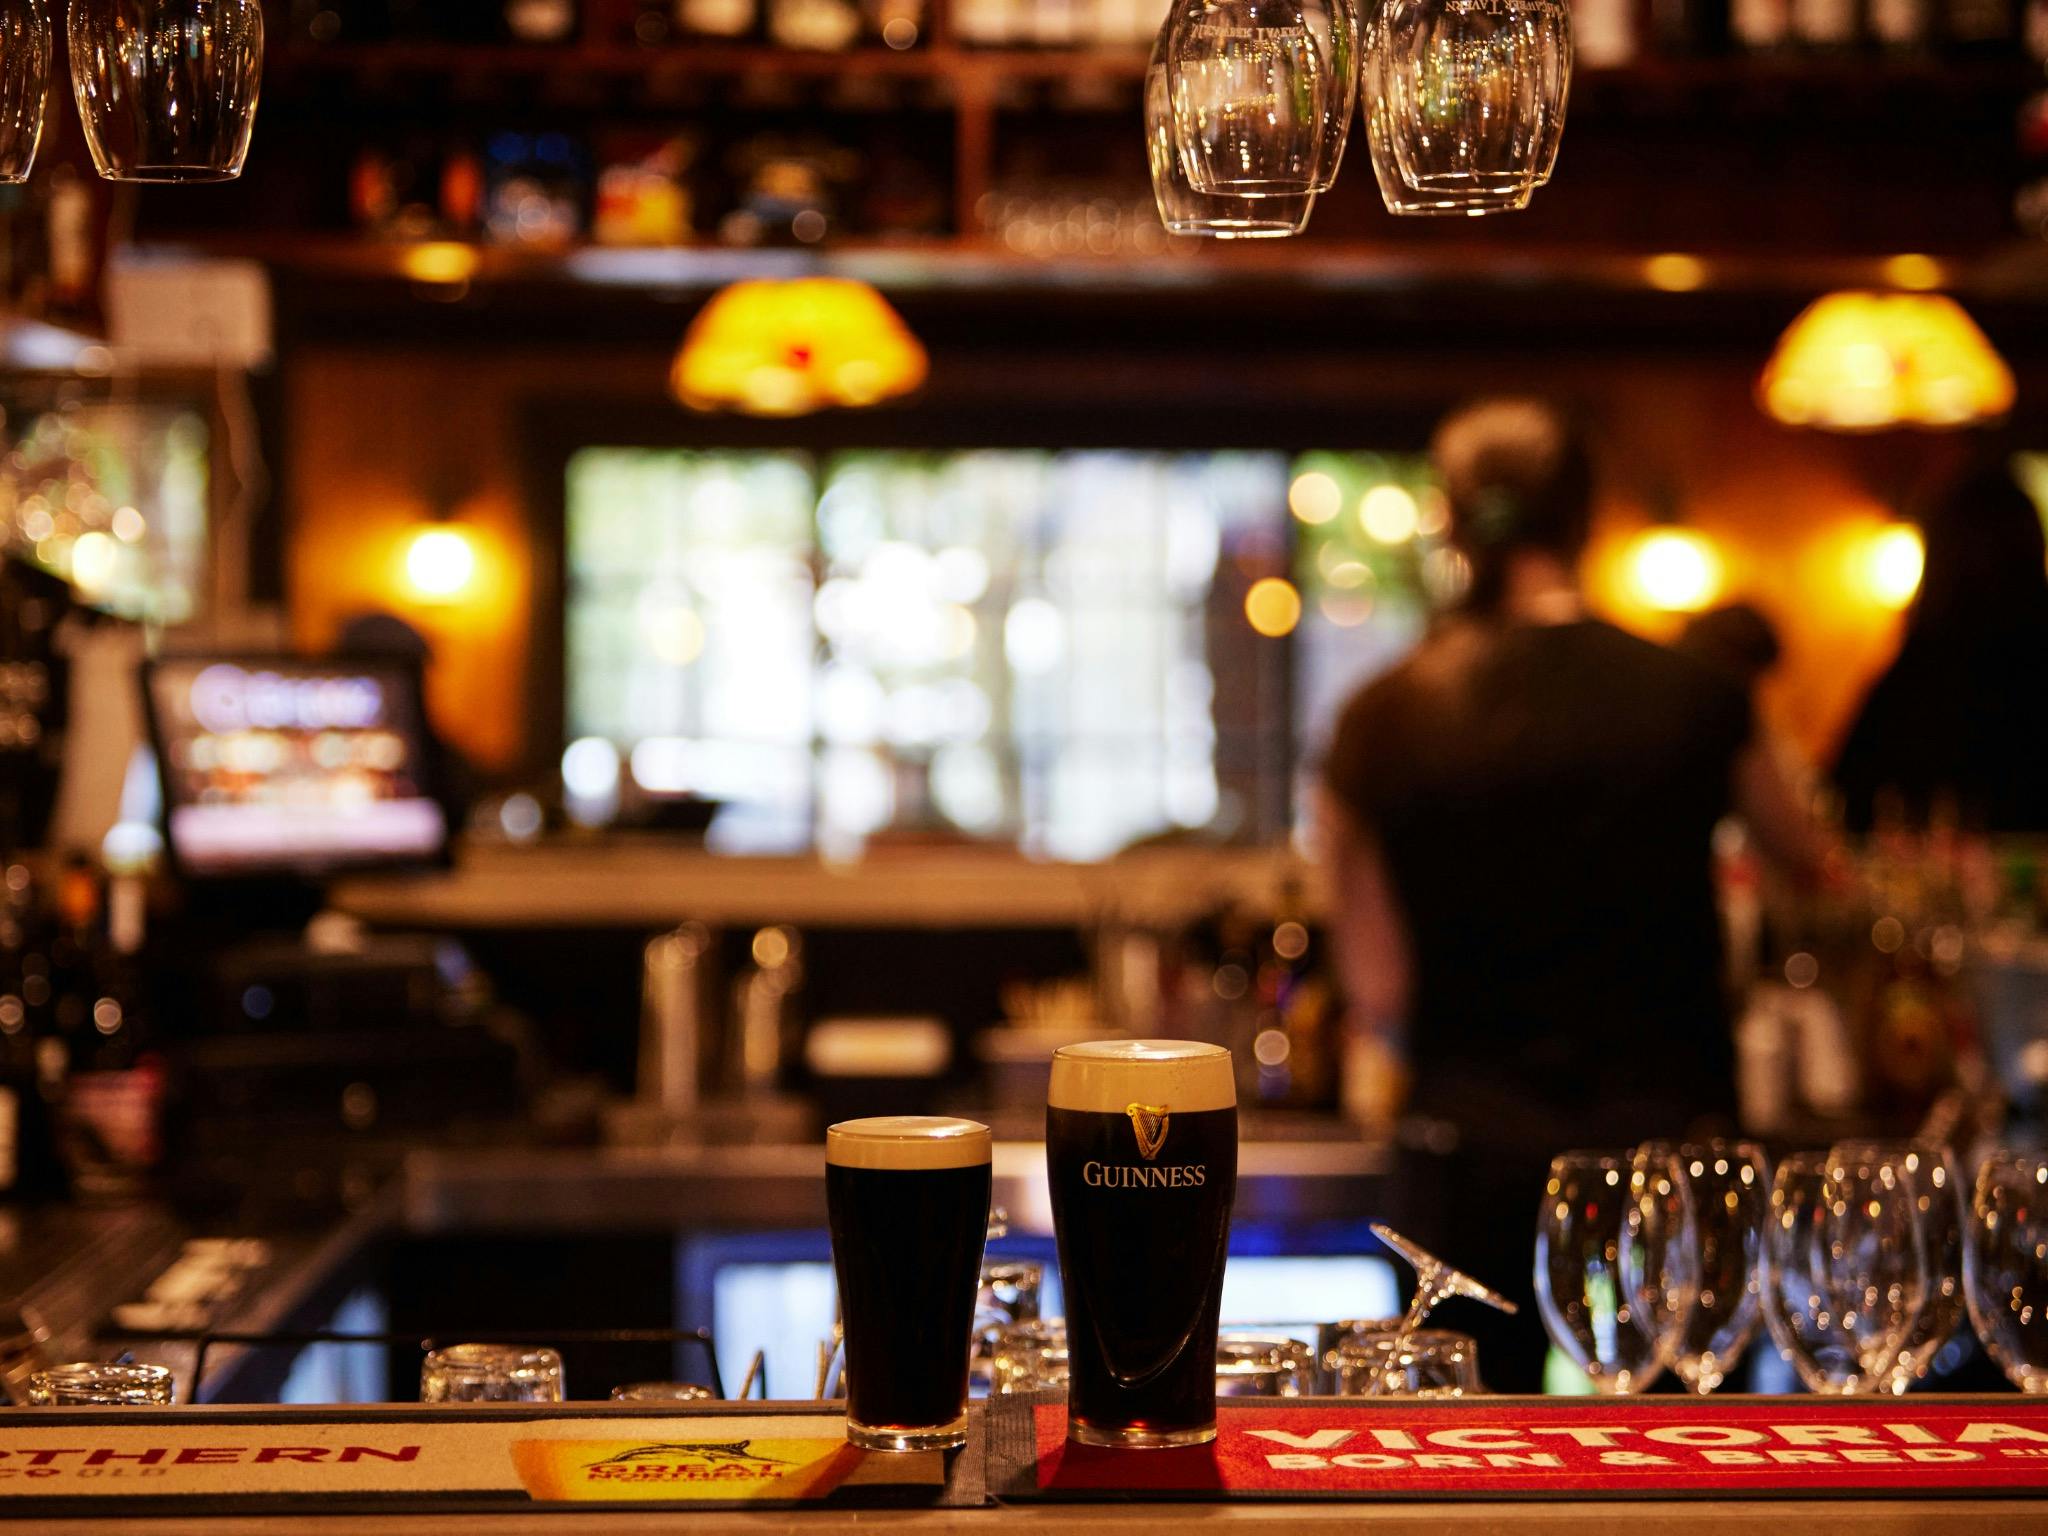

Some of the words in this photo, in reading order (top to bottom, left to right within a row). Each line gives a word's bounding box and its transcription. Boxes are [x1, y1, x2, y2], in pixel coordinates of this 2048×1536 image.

[1083, 1161, 1206, 1188] GUINNESS
[1241, 1422, 2048, 1449] VICTORIA
[589, 1463, 784, 1473] GREAT
[1264, 1452, 1565, 1470] BORN
[1599, 1451, 1681, 1466] &
[1698, 1448, 1984, 1465] BRED
